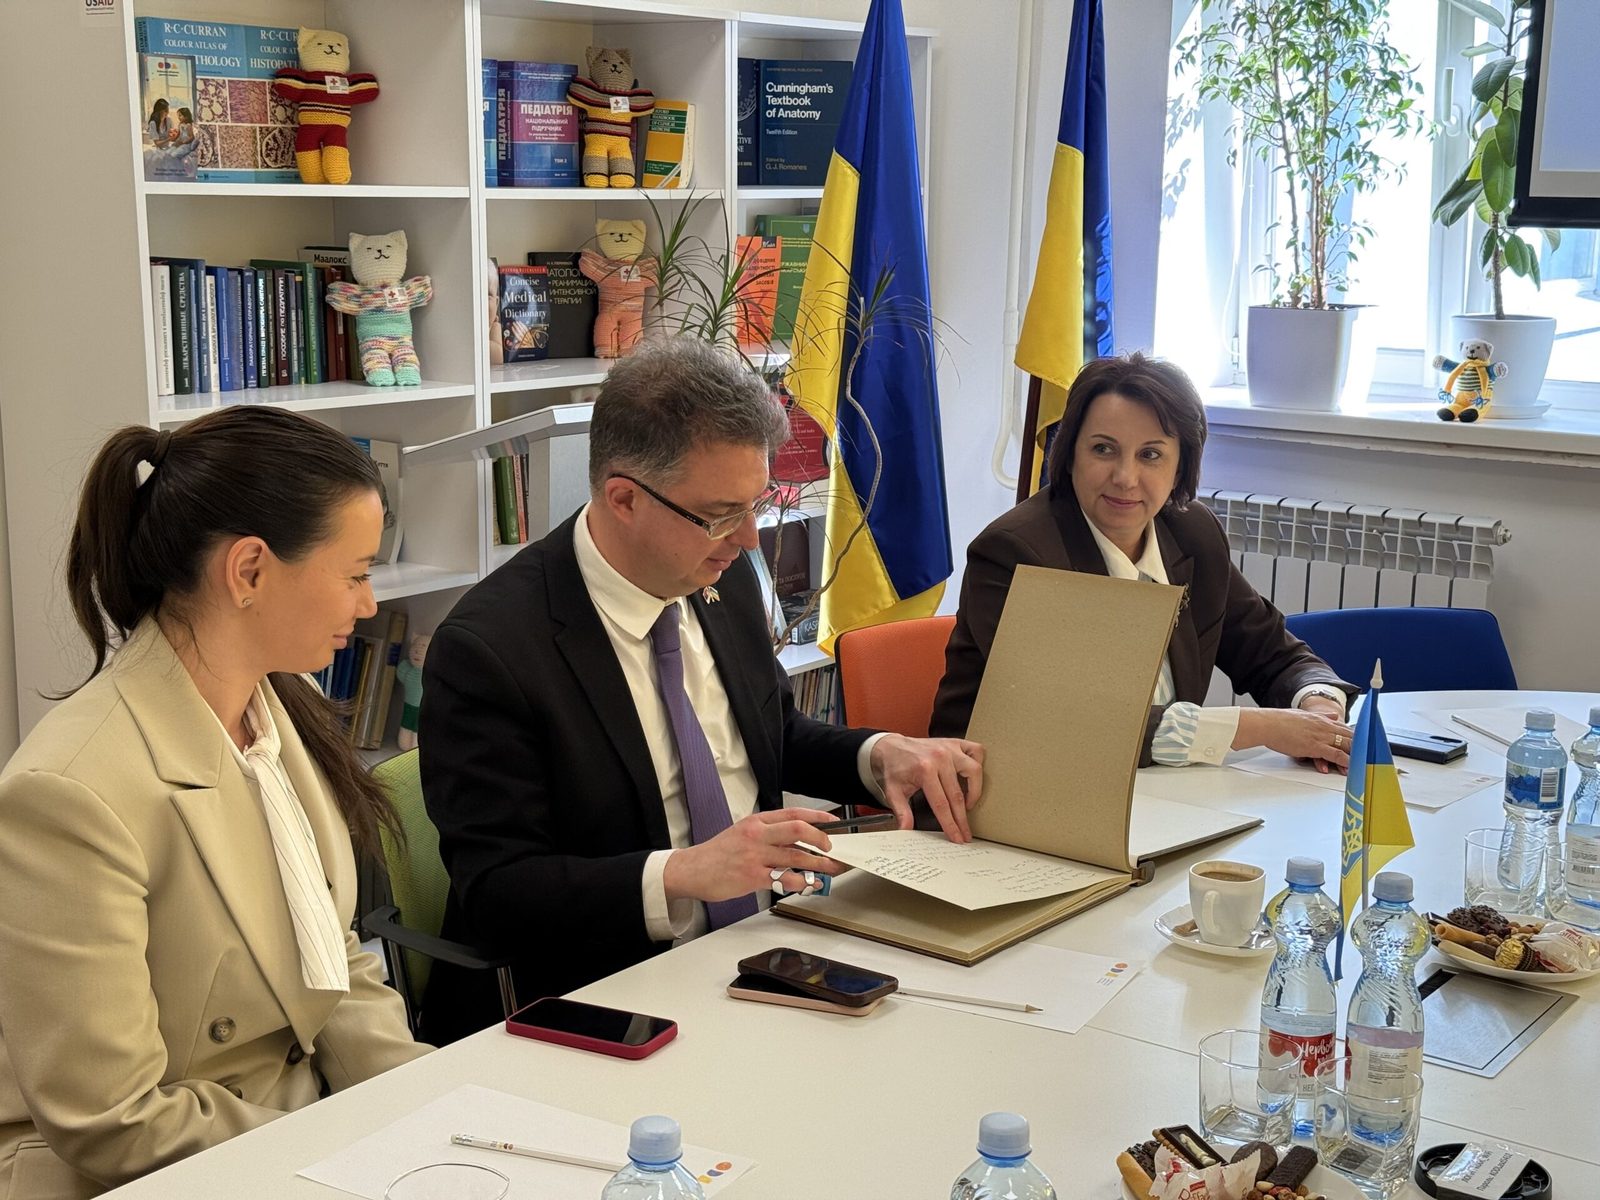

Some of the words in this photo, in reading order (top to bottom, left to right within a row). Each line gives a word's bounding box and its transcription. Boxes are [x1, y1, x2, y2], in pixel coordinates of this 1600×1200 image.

[164, 39, 194, 48] COLOUR
[195, 41, 217, 50] ATLAS
[218, 43, 228, 51] OF
[260, 46, 288, 55] COLOUR
[766, 82, 834, 95] Cunningham's
[766, 95, 811, 106] Textbook
[520, 103, 573, 117] ПЕДІАТРІЯ
[766, 108, 776, 118] of
[777, 108, 821, 120] Anatomy
[313, 254, 347, 264] Маалокс
[509, 276, 540, 286] Concise
[504, 290, 547, 303] Medical
[504, 308, 546, 319] Dictionary
